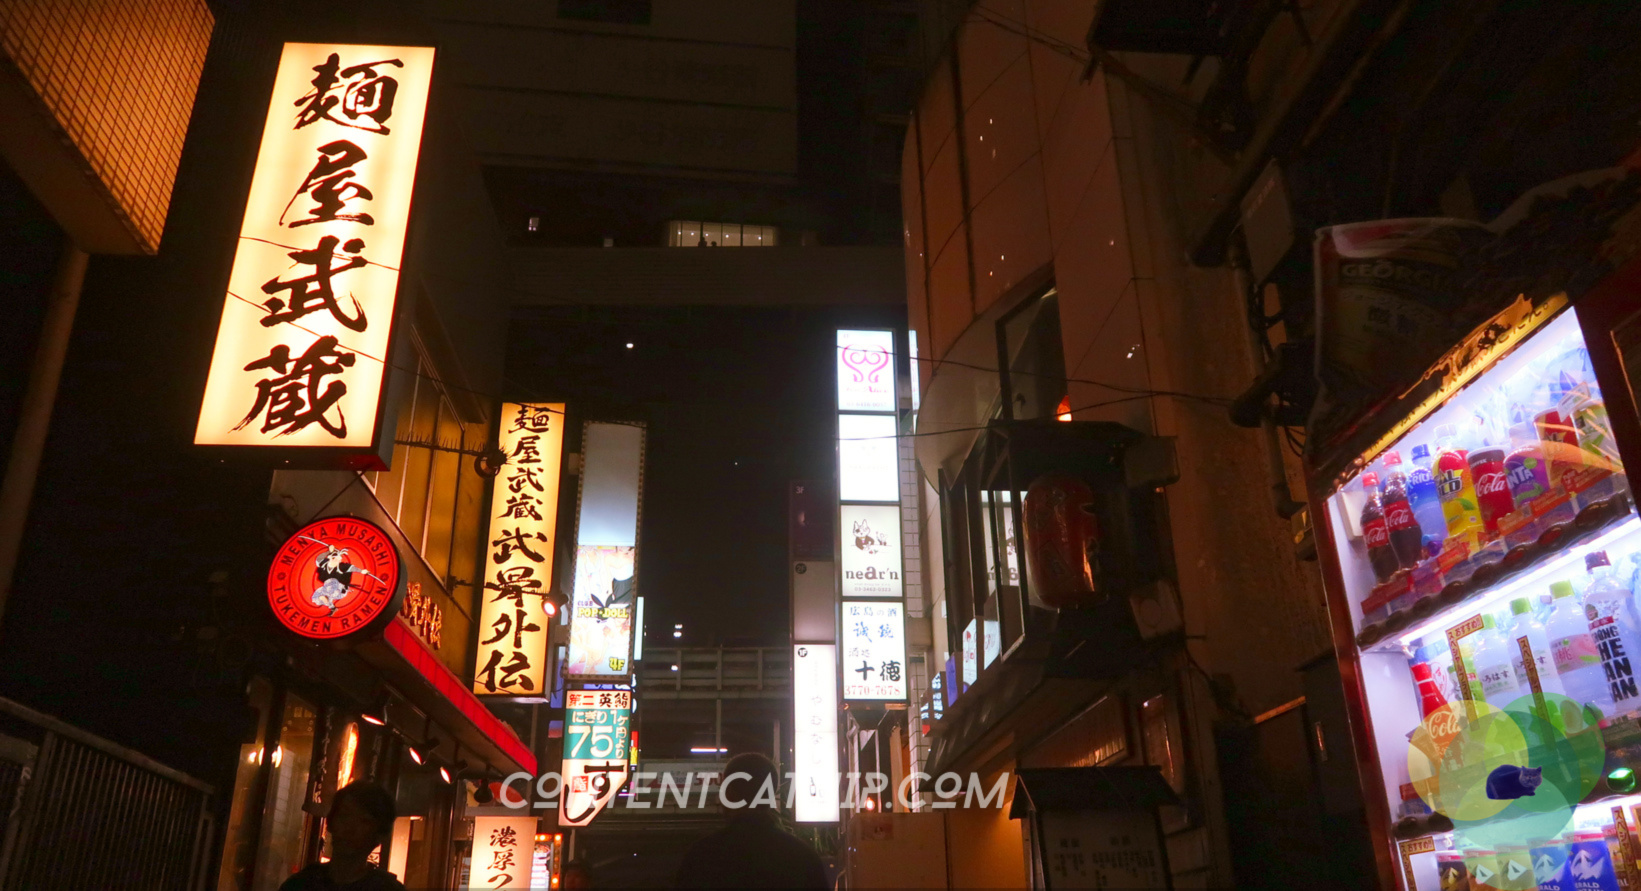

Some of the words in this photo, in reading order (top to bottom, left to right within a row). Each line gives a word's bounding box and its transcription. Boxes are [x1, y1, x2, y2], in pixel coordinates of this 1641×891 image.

[228, 53, 403, 439] 麺屋武蔵
[281, 527, 329, 566] MENYA
[336, 523, 390, 567] MUSASHI
[274, 585, 331, 633] TUKEMEN
[341, 587, 388, 630] RAMEN
[1597, 637, 1626, 662] HE
[1602, 656, 1633, 682] AN
[1608, 676, 1639, 703] AN
[568, 725, 614, 758] 75
